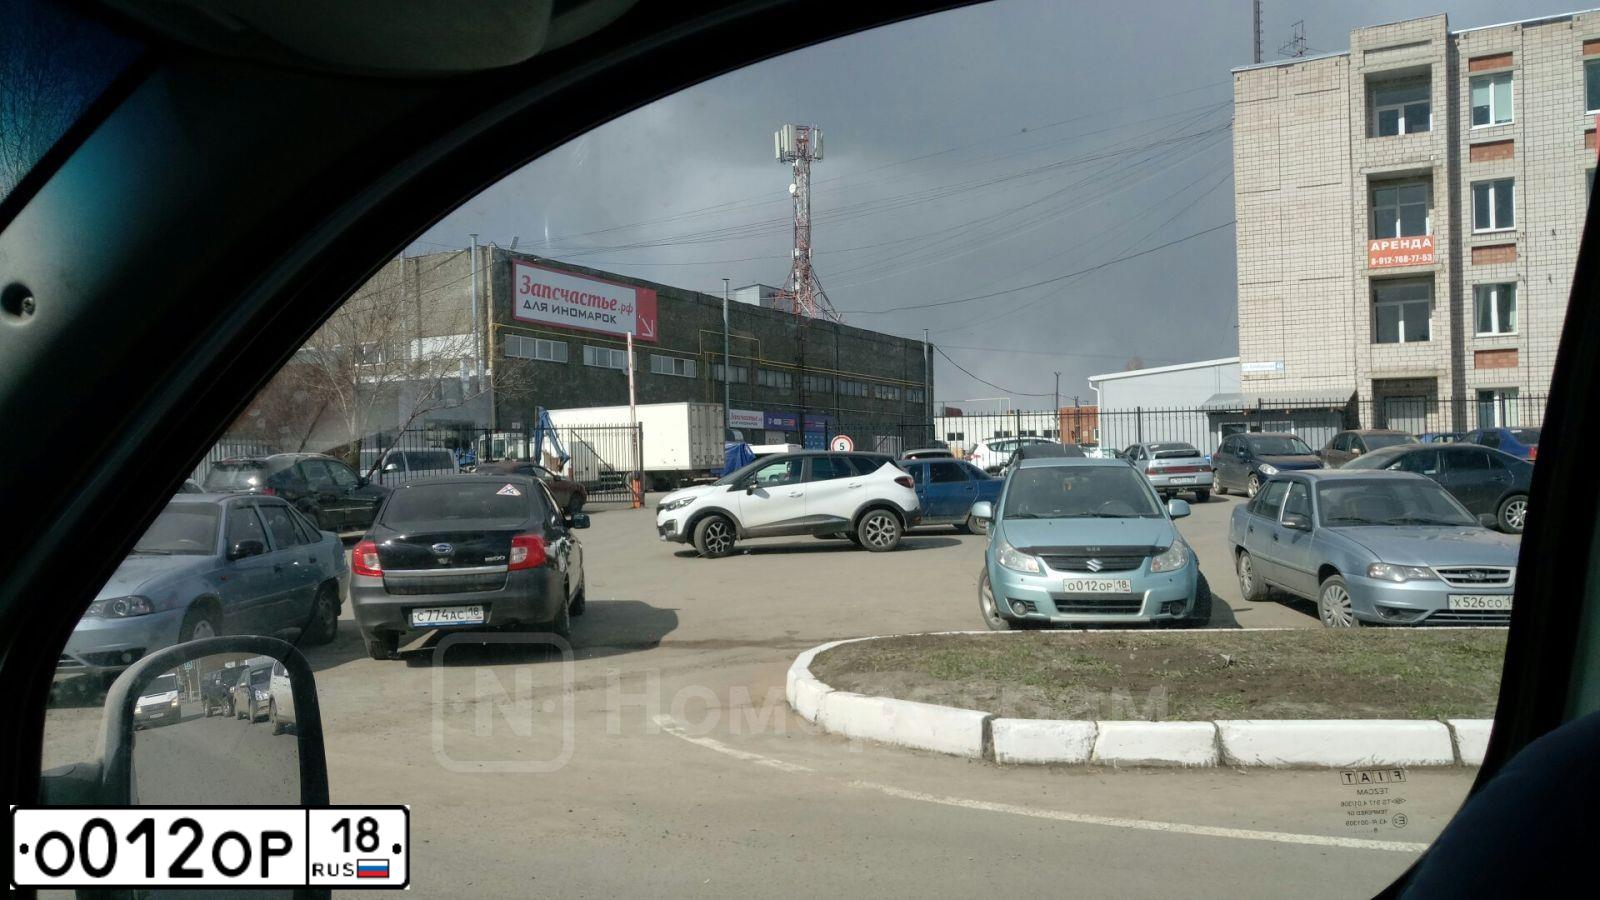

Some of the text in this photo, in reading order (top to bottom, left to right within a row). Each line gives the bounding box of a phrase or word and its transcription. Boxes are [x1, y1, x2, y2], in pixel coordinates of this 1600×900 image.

[1371, 238, 1432, 251] АРЕНДА
[523, 300, 617, 325] ДЛЯ ИНОМАРОК
[839, 442, 845, 451] 5
[1067, 580, 1127, 591] О012ОР 18
[1454, 597, 1503, 608] Х526СО
[416, 608, 465, 622] С774АС
